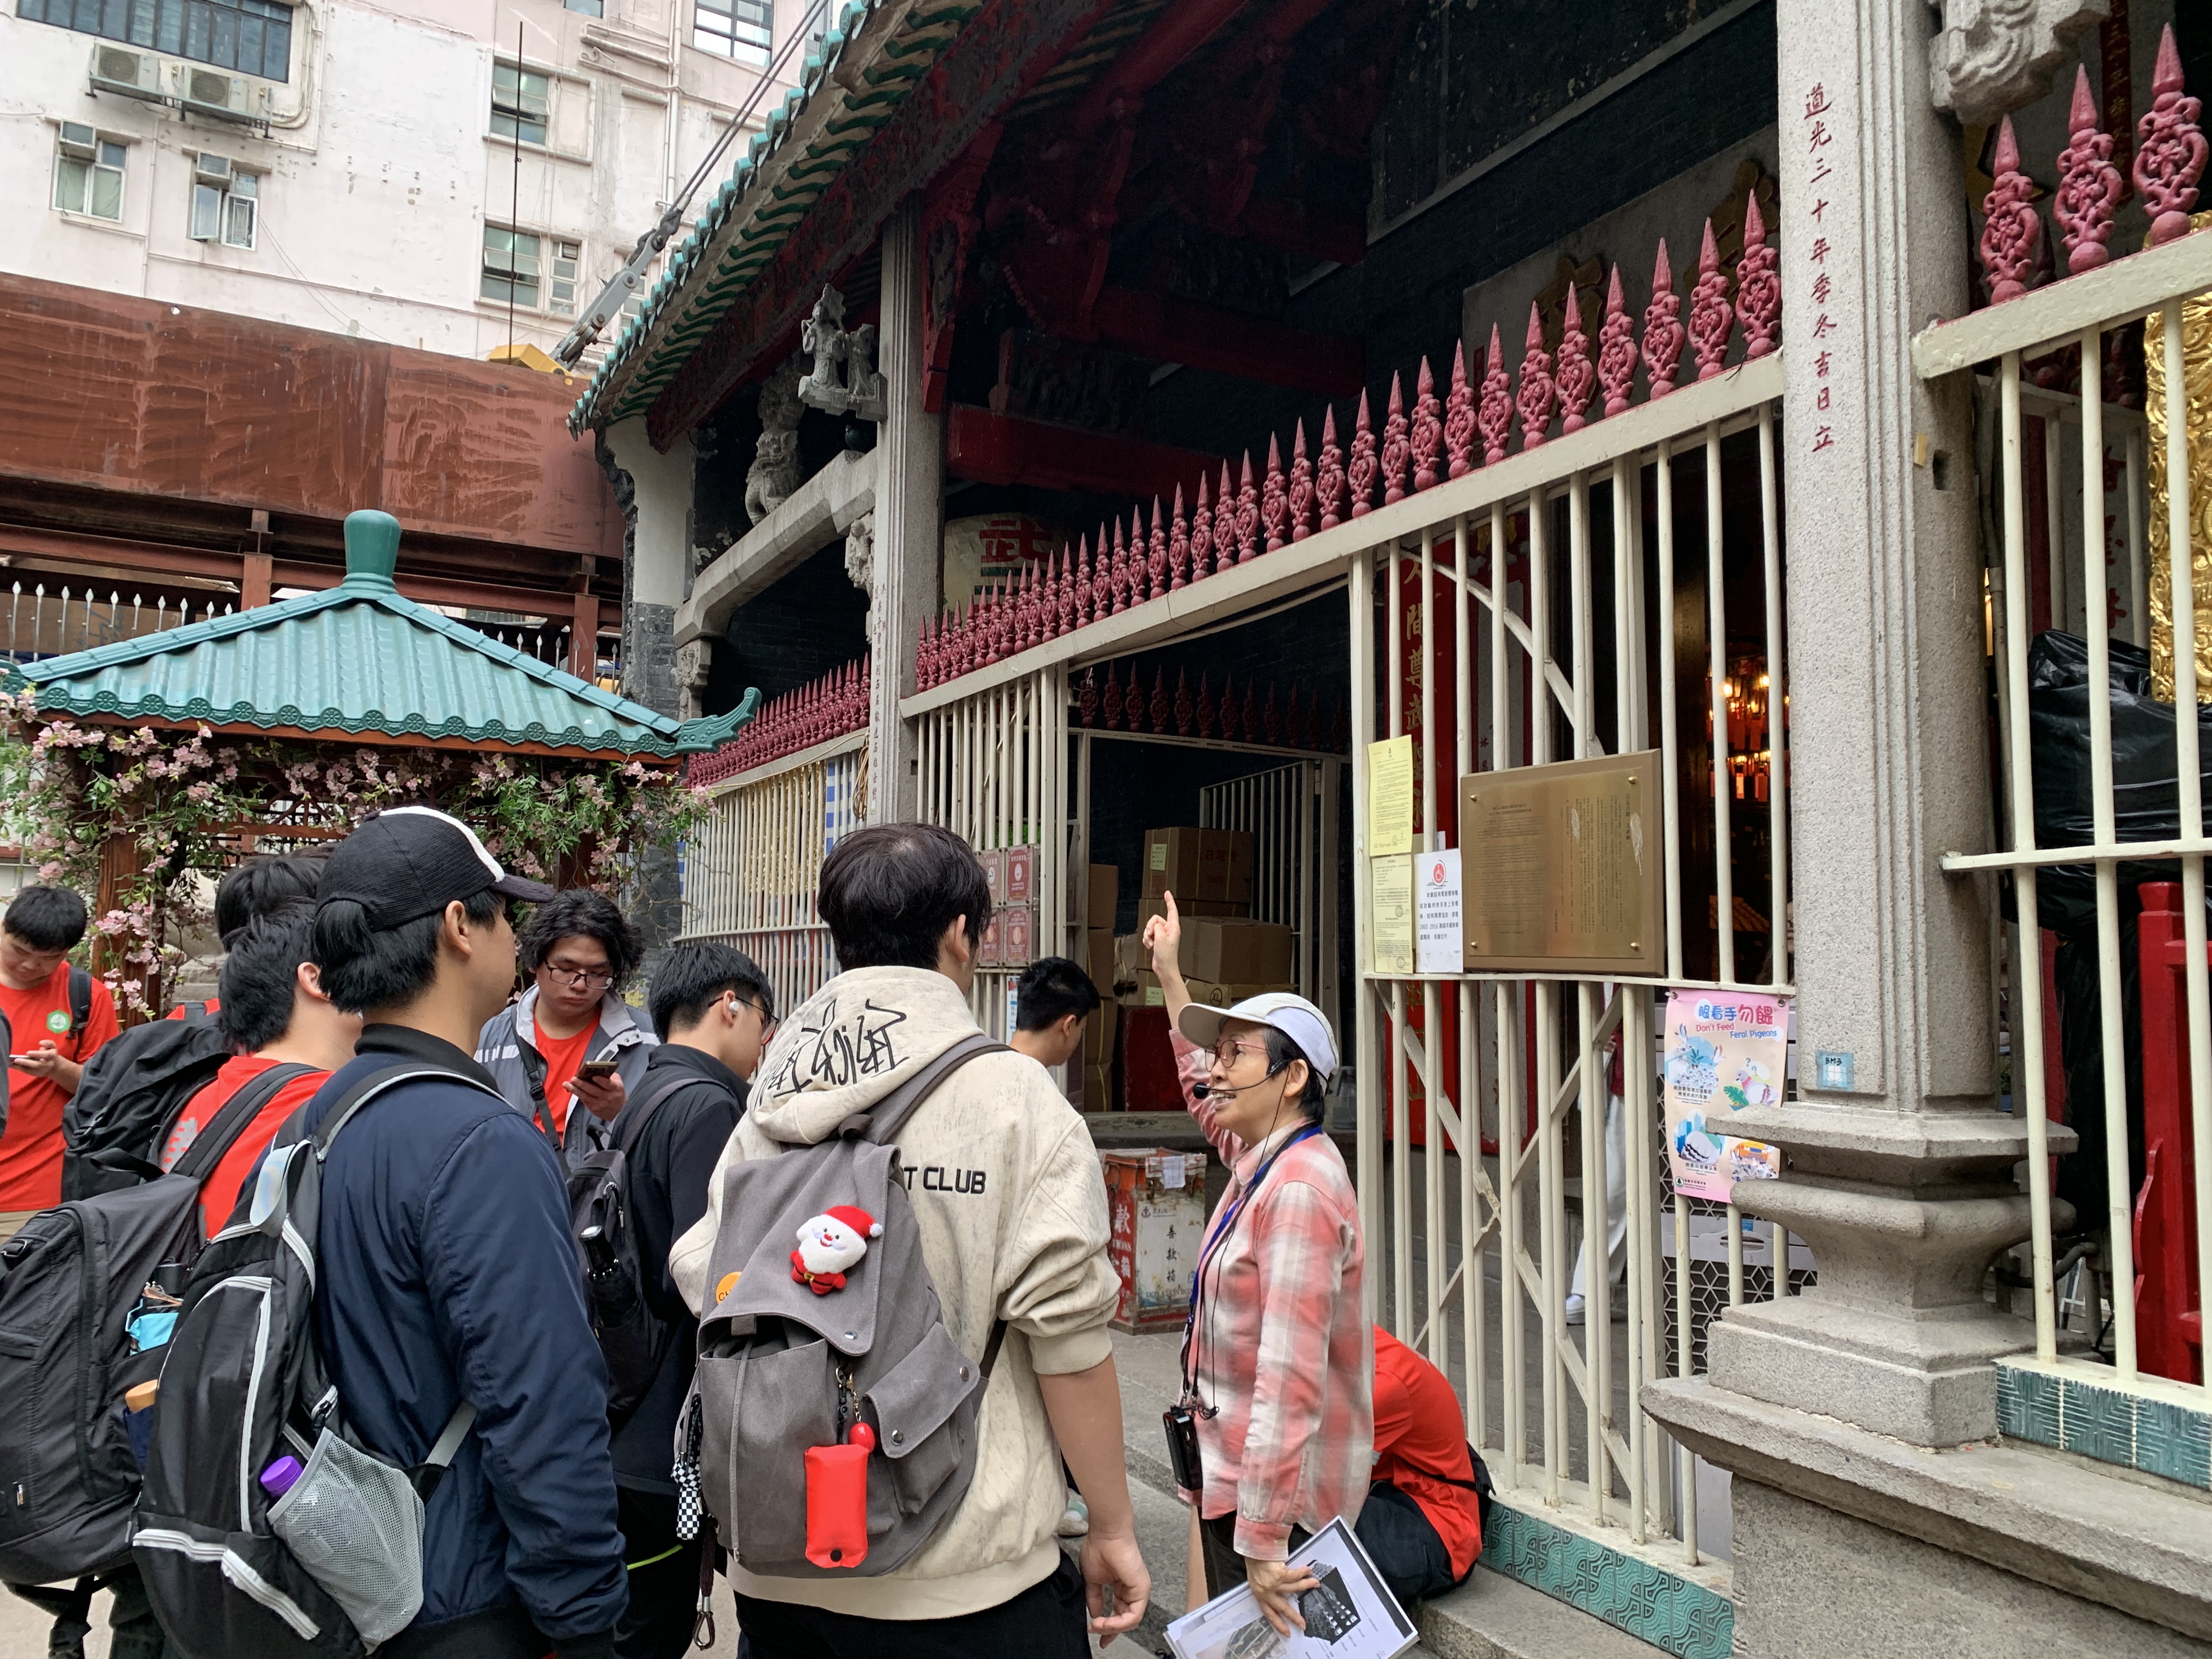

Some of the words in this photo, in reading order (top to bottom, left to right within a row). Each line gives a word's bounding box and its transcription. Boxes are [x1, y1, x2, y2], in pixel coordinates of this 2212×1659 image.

[1211, 992, 1222, 1002] XL
[1696, 1024, 1716, 1032] Don't
[1717, 1023, 1735, 1031] Feed
[1730, 1030, 1748, 1038] Feral
[1750, 1030, 1778, 1039] Pigeons
[1825, 1057, 1842, 1066] BM3
[923, 1166, 986, 1194] CLUB
[1166, 1224, 1177, 1282] 善款箱
